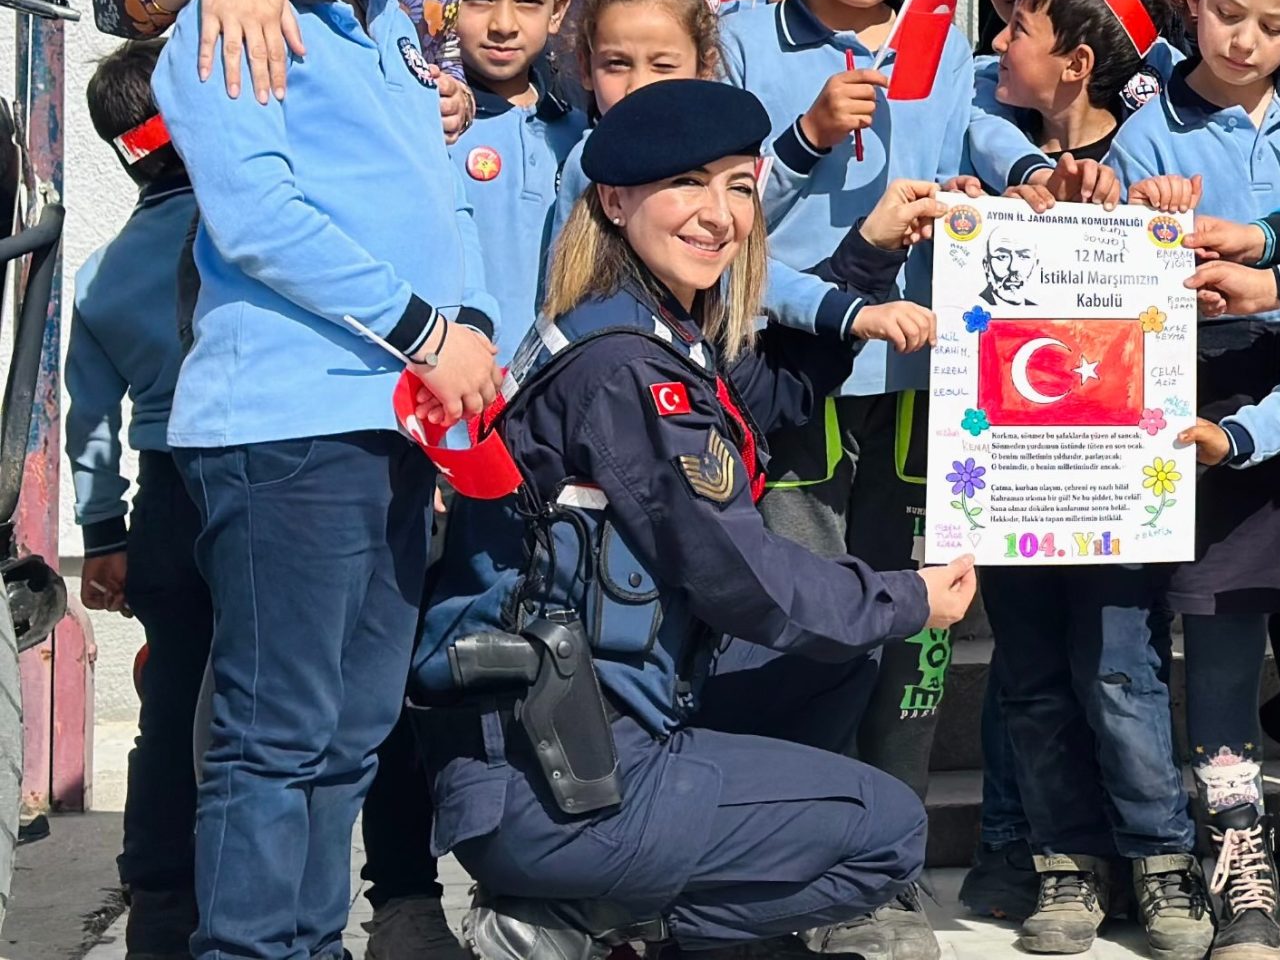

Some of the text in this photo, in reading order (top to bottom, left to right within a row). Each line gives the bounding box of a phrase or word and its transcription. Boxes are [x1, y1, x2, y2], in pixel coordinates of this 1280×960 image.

[987, 211, 1143, 227] AYDIN İL JANDARMA KOMUTANLIĞI
[1074, 249, 1125, 263] 12 Mart
[1040, 267, 1159, 288] İstiklal Marşımızın
[1077, 293, 1123, 308] Kabulü
[1004, 532, 1066, 558] 104.
[1072, 531, 1121, 556] Yılı
